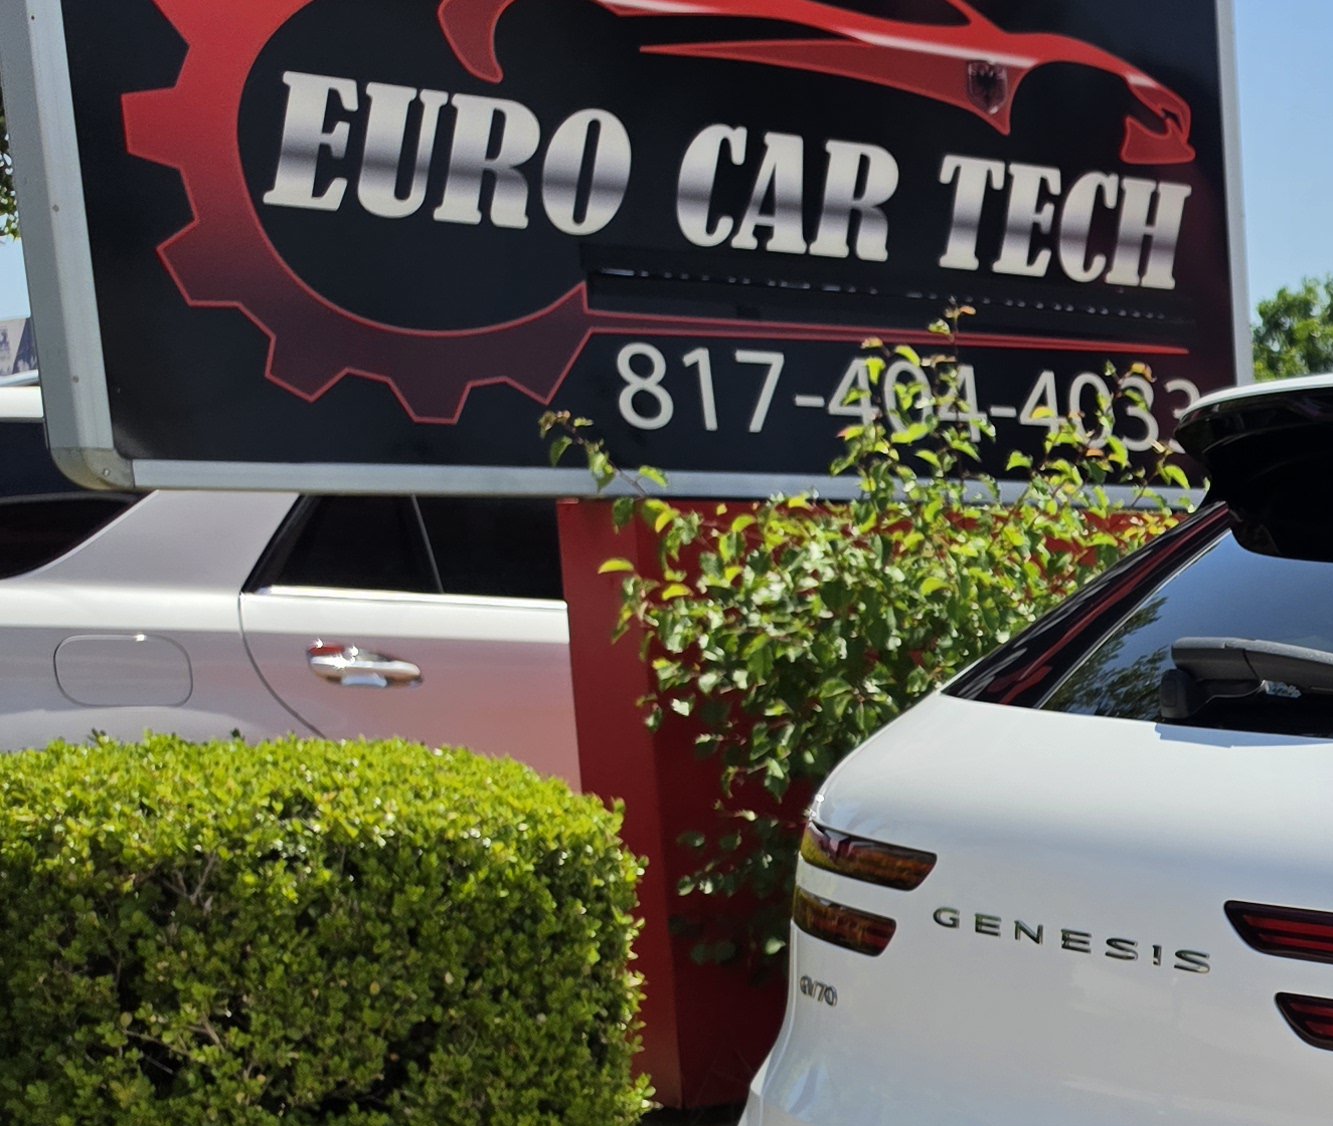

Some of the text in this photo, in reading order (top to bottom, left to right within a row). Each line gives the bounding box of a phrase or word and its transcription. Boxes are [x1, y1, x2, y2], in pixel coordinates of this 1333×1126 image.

[261, 69, 1194, 293] EURO CAR TECH
[932, 906, 1212, 975] GENESIS
